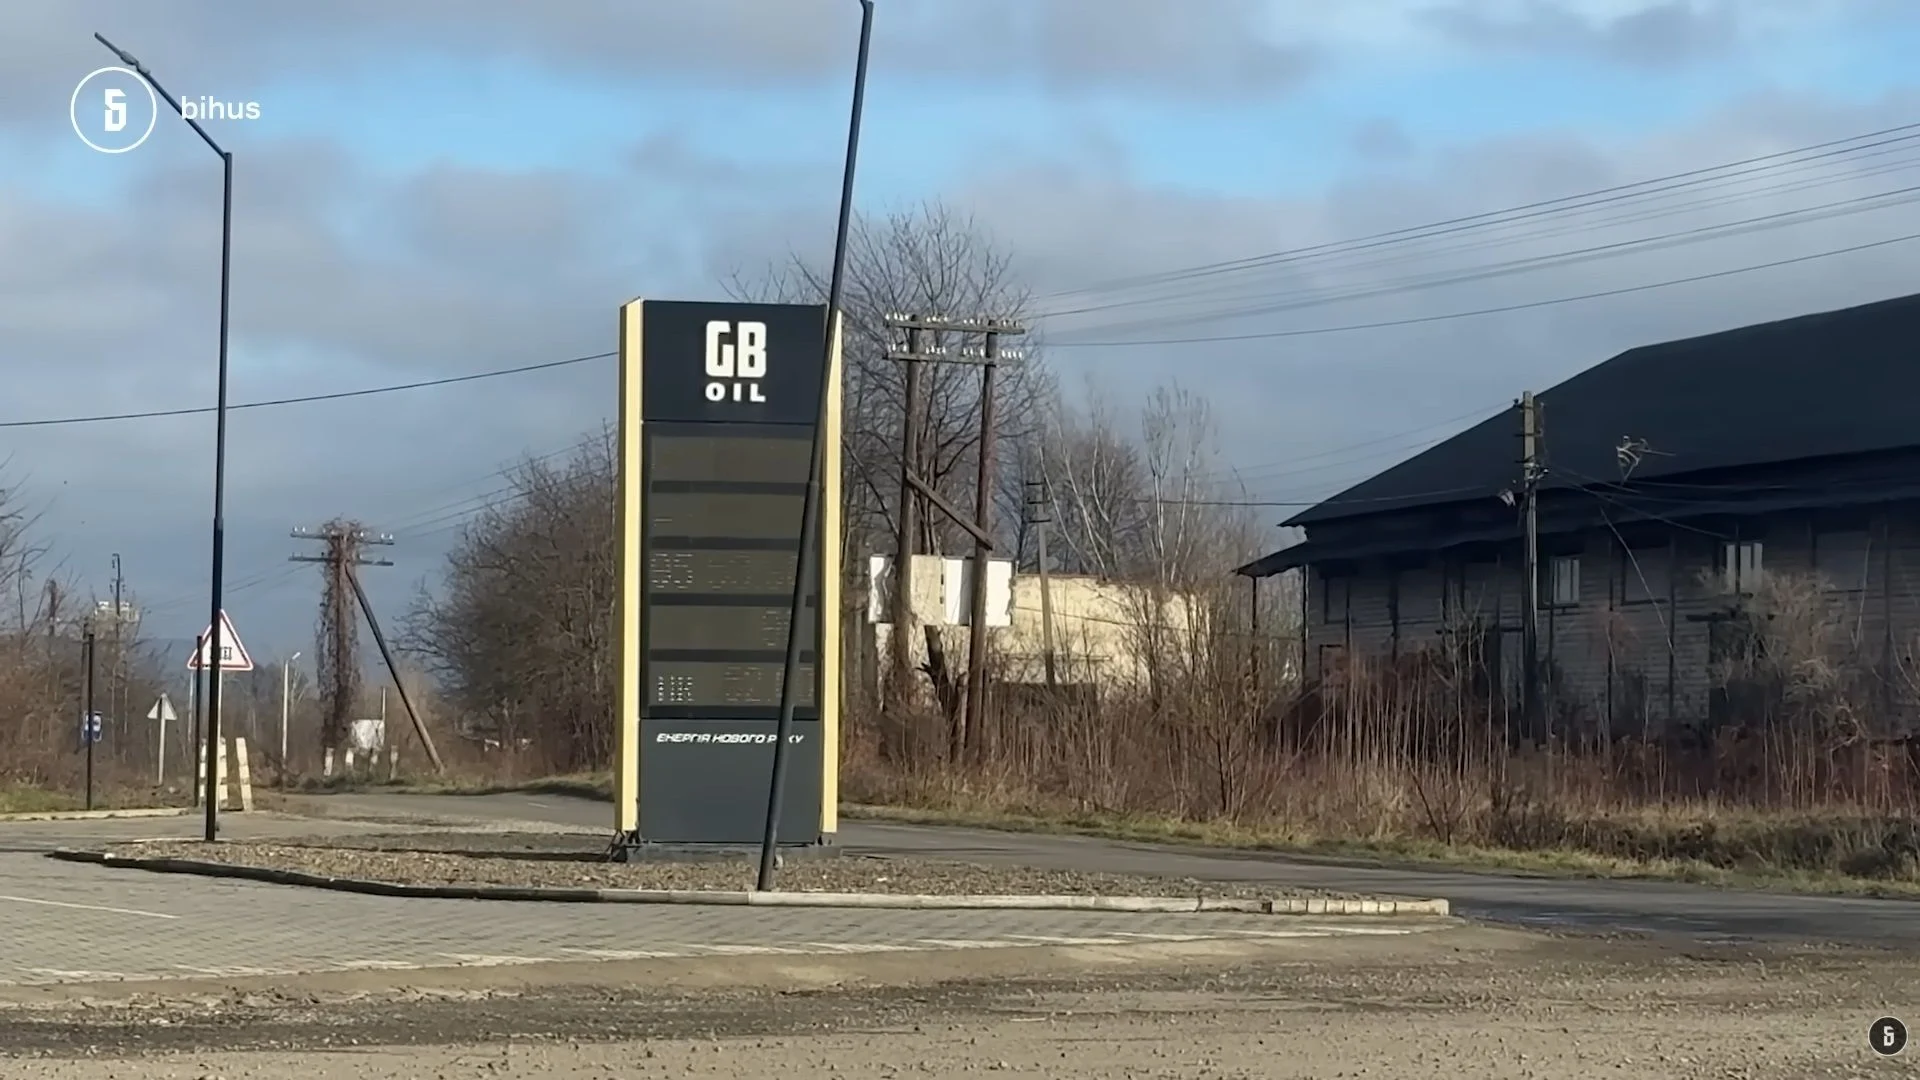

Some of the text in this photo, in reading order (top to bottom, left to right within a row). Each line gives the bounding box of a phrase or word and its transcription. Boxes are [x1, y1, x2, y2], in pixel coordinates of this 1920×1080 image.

[705, 320, 767, 378] GB
[705, 382, 766, 402] OIL
[712, 733, 765, 743] НОВОГО
[766, 734, 804, 744] РУ
